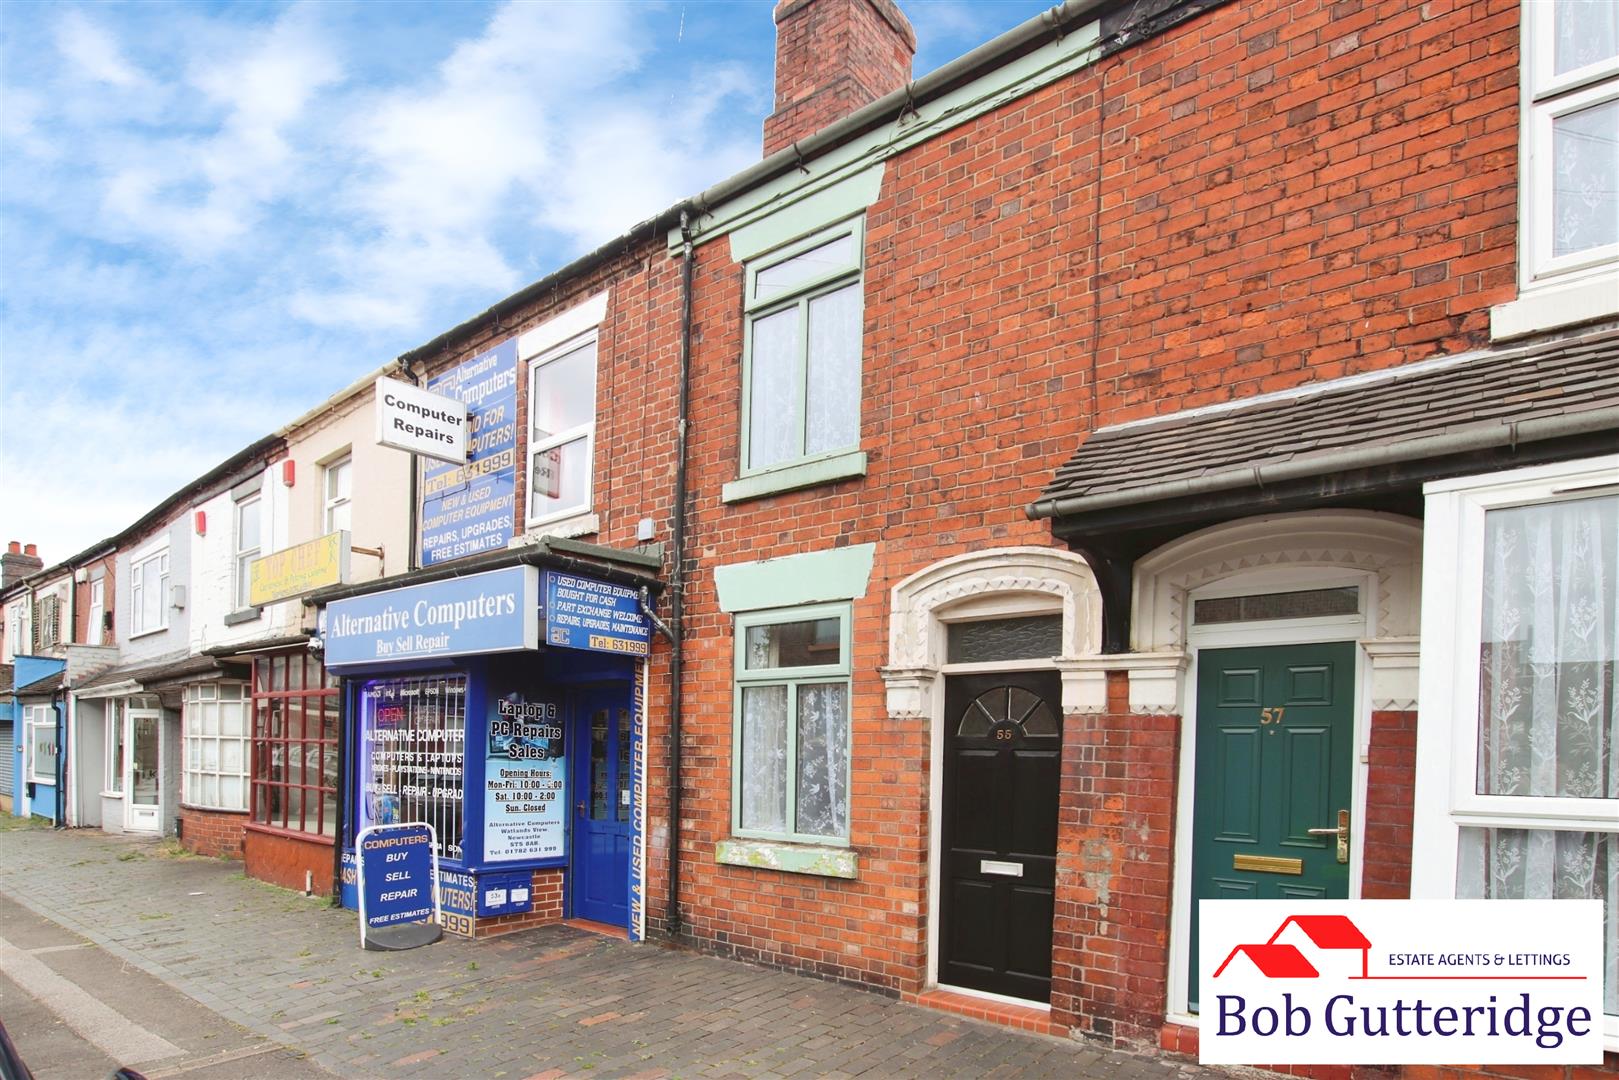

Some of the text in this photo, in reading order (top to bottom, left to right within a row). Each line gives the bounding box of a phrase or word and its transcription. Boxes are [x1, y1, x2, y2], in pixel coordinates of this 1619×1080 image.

[456, 355, 498, 384] Alternative
[455, 367, 516, 405] Computers
[384, 394, 462, 426] Computer
[483, 405, 504, 429] FOR
[394, 418, 454, 444] Repairs
[470, 423, 514, 453] PUTERS!
[442, 496, 460, 511] NEW
[468, 486, 491, 503] USED
[423, 494, 514, 531] COMPUTER EQUIPMENT
[462, 515, 512, 539] UPGRADES,
[431, 532, 502, 561] FREE ESTIMATES
[557, 576, 640, 599] USED COMPUTER EQUIPME
[557, 588, 616, 606] BOUGHT FOR CASH
[330, 592, 516, 638] Alternative Computers
[556, 600, 643, 624] PART EXCHANGE WELCOME
[612, 622, 648, 636] MAINTENANCE
[376, 632, 450, 656] Buy Sell Repair
[591, 636, 609, 647] Tel:
[612, 640, 647, 654] 631999
[378, 706, 404, 722] OPEN
[498, 699, 556, 720] Laptop &
[1260, 708, 1285, 724] 57
[366, 728, 414, 742] ALTERNATIVE
[491, 720, 562, 741] PC Repairs
[996, 729, 1012, 740] 55
[371, 752, 414, 762] COMPUTERS
[427, 752, 462, 763] LAPTOPS
[509, 742, 544, 758] Sales
[500, 768, 552, 778] Opening Hours:
[383, 784, 398, 794] SELL
[402, 785, 428, 796] REPAIR
[520, 780, 540, 788] 10:00
[633, 741, 643, 831] COMPUTER
[512, 792, 532, 800] 10:00
[540, 792, 556, 800] 2:00
[524, 804, 546, 812] Closed
[364, 834, 428, 850] COMPUTERS
[386, 852, 408, 863] BUY
[632, 838, 642, 880] USED
[385, 870, 412, 882] SELL
[430, 869, 474, 888] ETIMATES
[380, 888, 418, 902] REPAIR
[632, 884, 640, 896] &
[369, 908, 430, 925] FREE ESTIMATES
[631, 897, 640, 938] NEW
